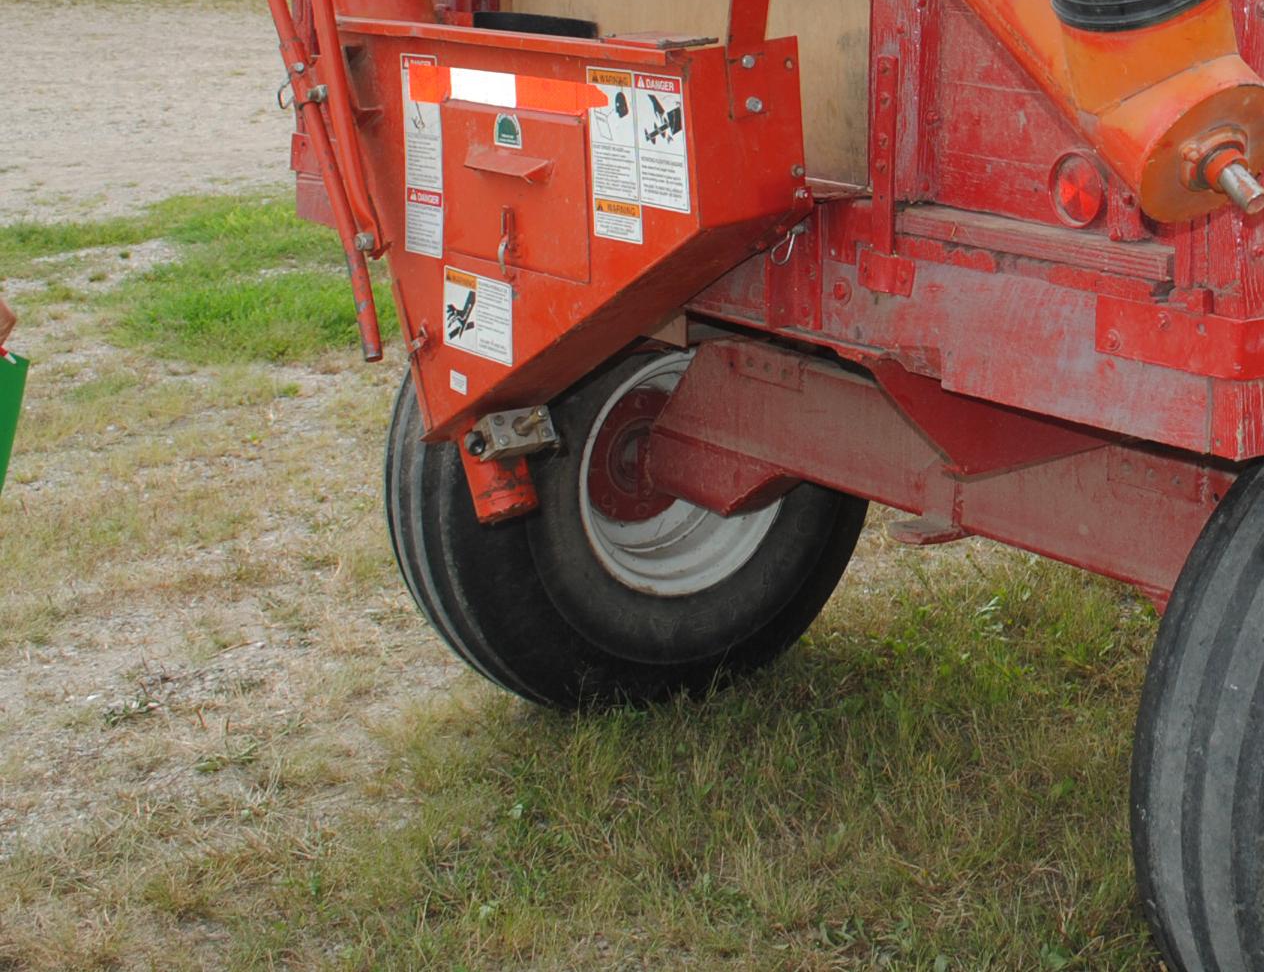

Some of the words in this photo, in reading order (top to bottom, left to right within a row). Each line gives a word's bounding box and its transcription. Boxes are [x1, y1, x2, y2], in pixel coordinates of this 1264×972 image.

[646, 78, 675, 91] DANGER
[417, 192, 440, 205] DANGER
[607, 203, 636, 217] WARNING
